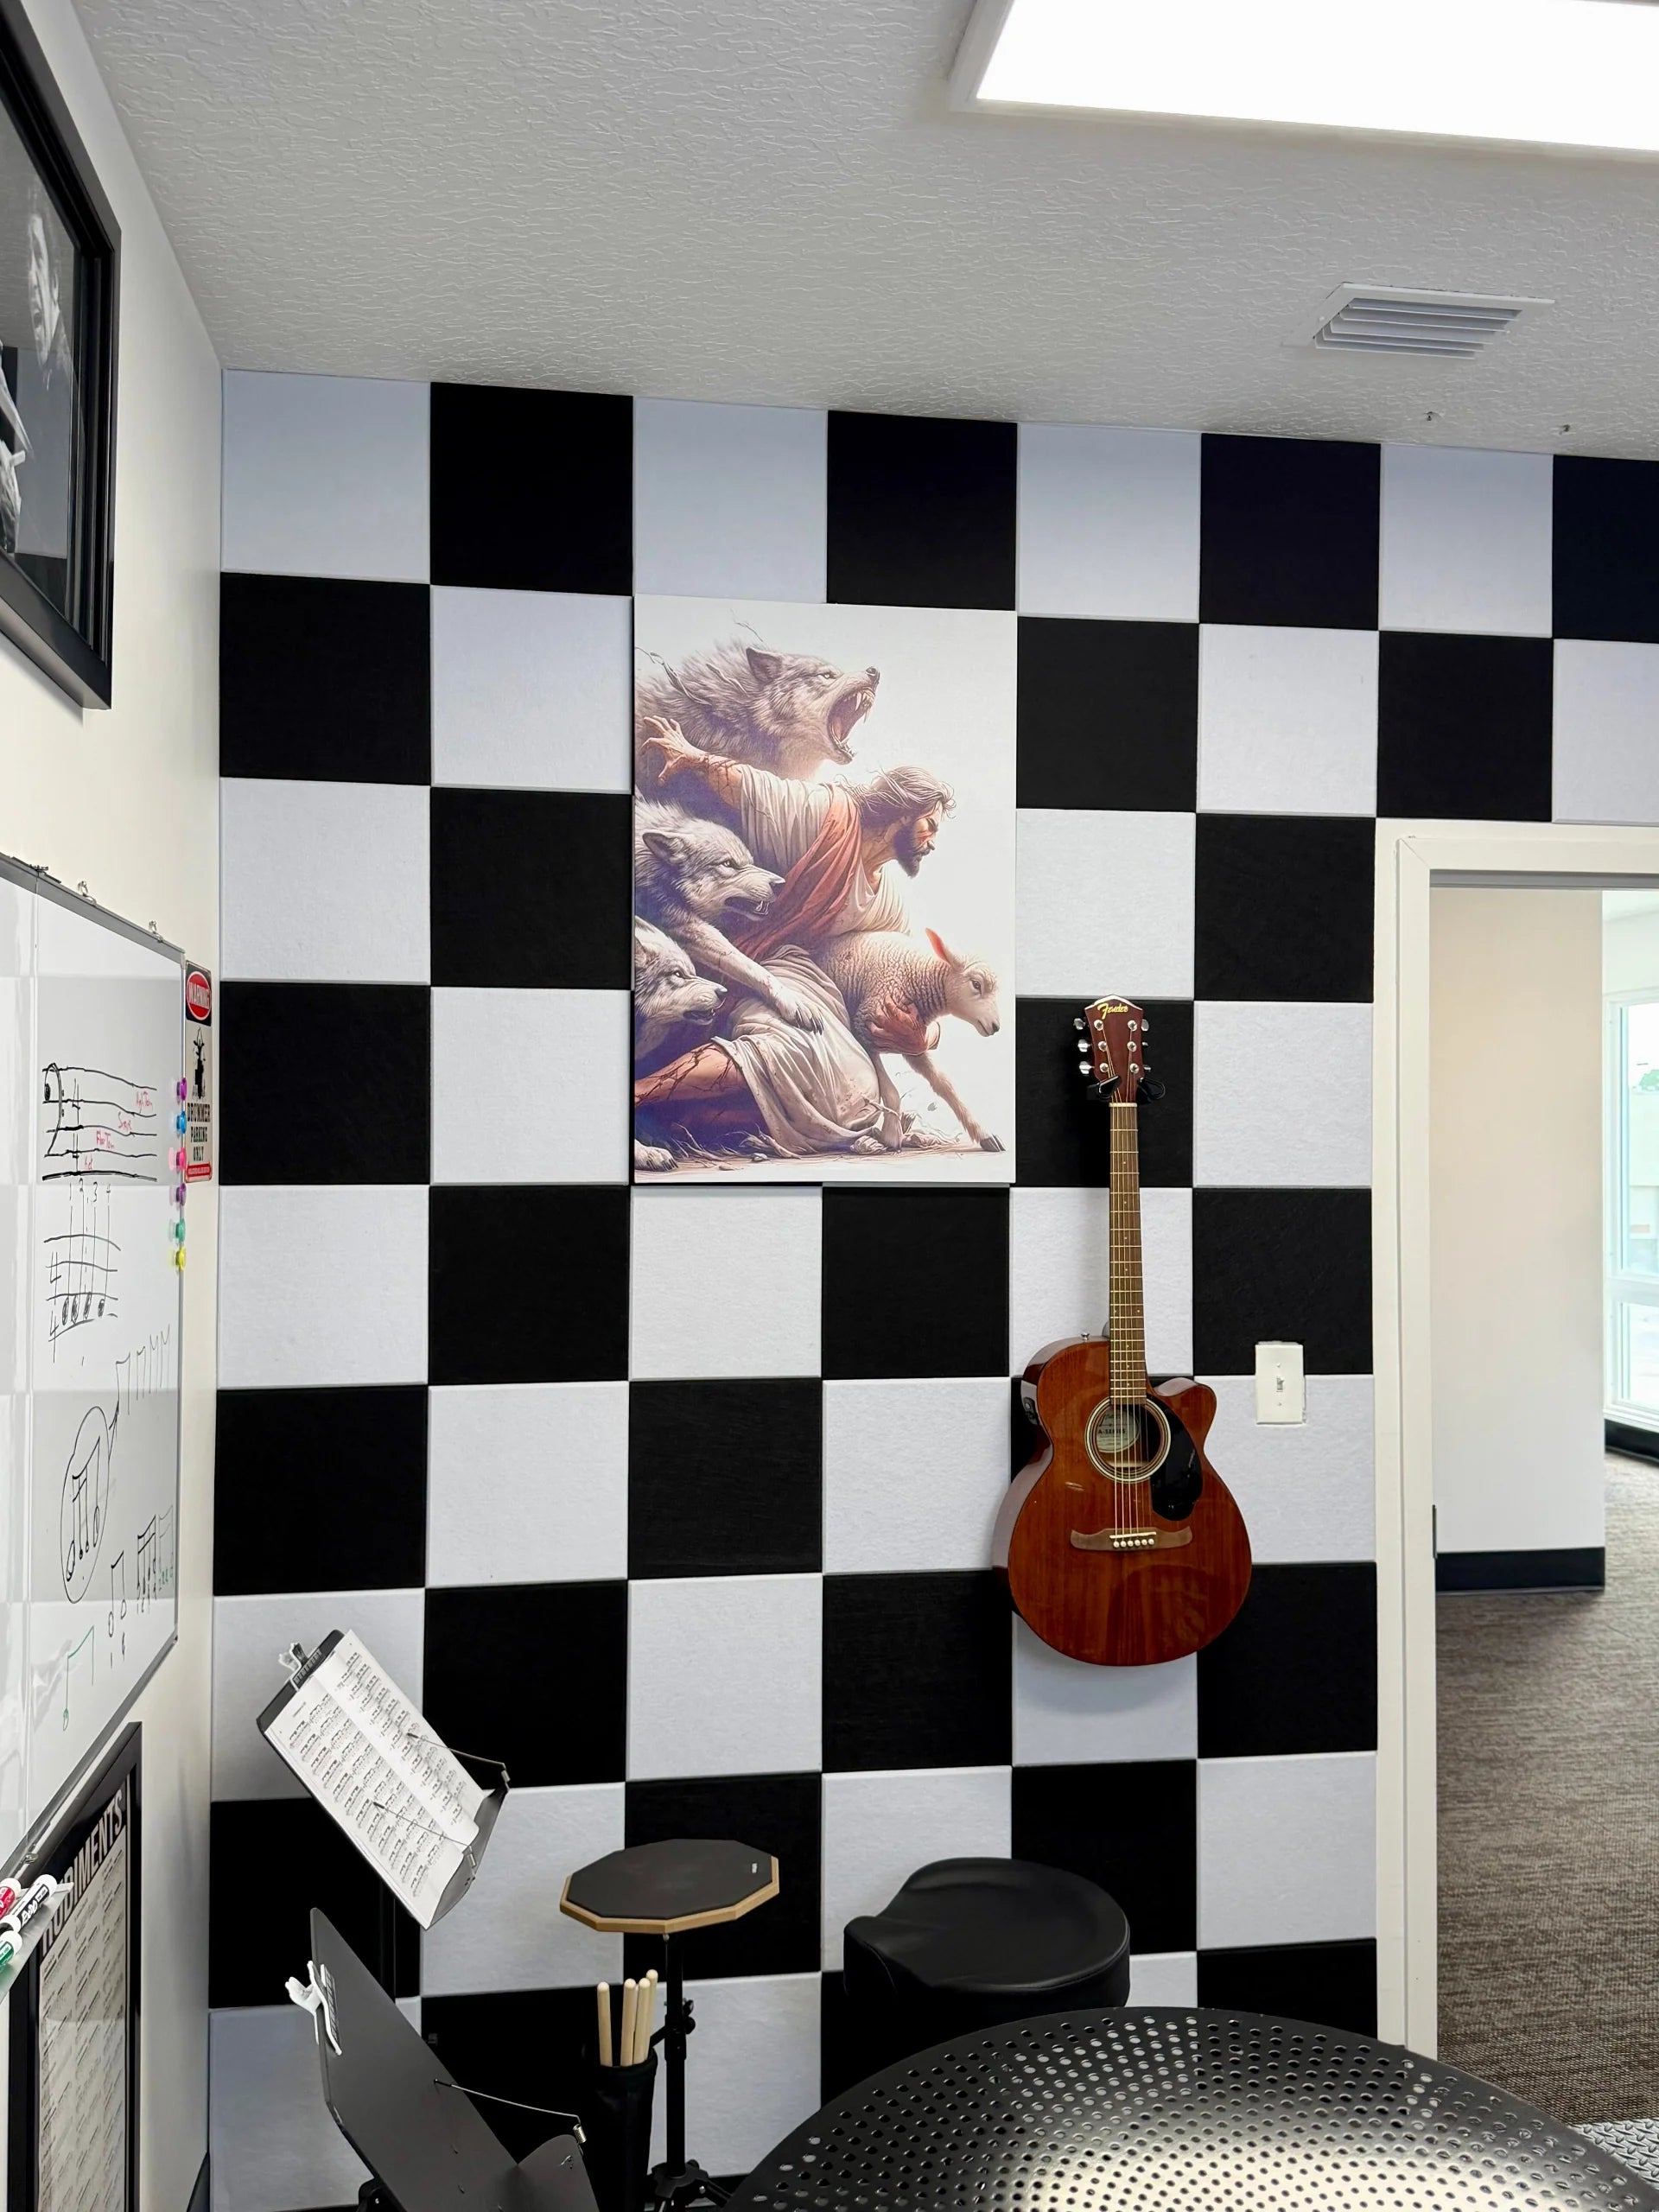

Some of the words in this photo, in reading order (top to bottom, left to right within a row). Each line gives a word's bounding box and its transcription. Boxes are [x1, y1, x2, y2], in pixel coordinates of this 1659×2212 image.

[1097, 1003, 1128, 1020] Fender
[187, 1103, 211, 1122] DRUMMER
[191, 1126, 207, 1143] PARKING
[193, 1146, 205, 1161] ONLY
